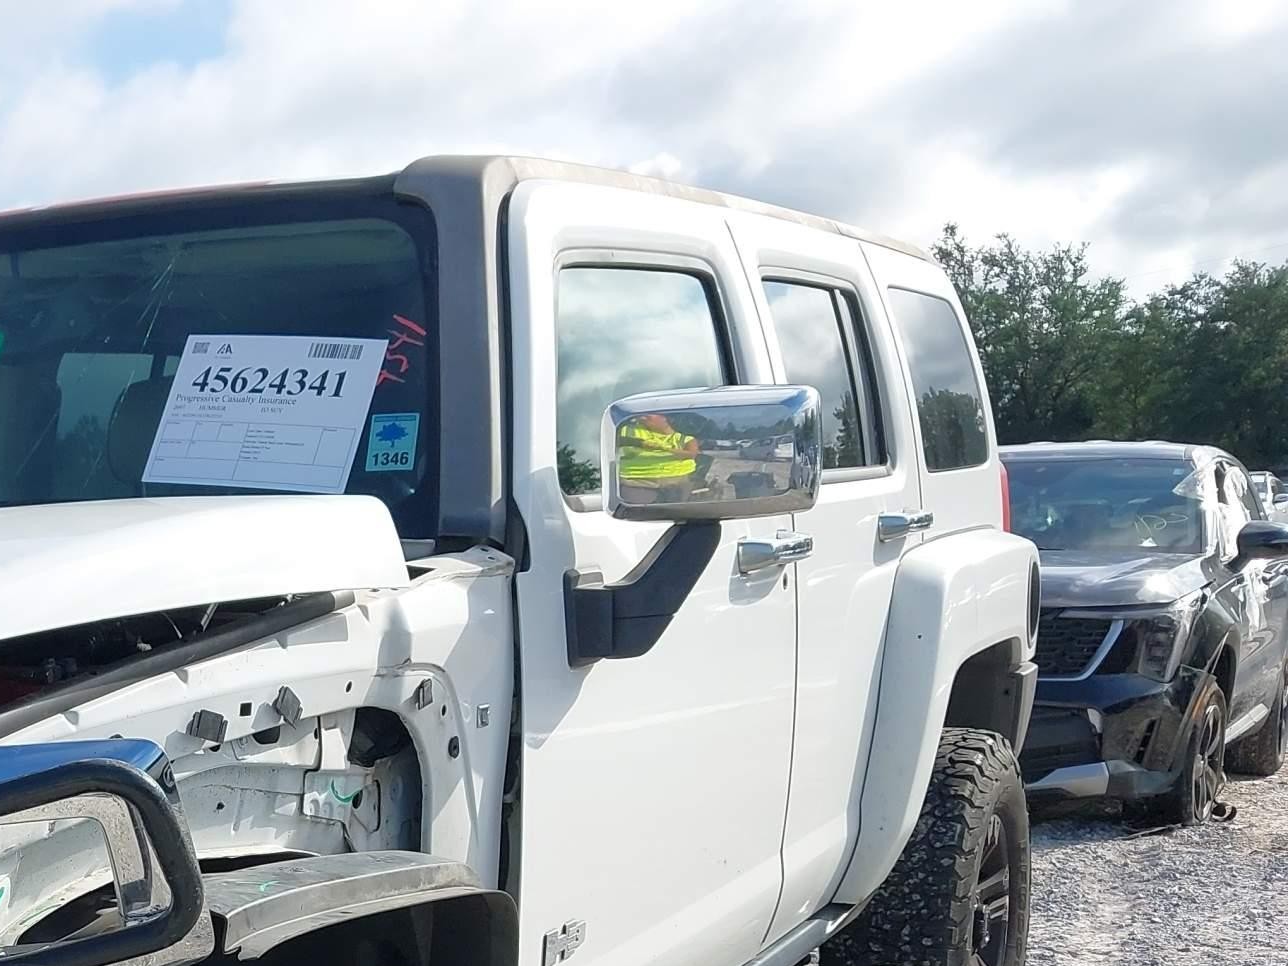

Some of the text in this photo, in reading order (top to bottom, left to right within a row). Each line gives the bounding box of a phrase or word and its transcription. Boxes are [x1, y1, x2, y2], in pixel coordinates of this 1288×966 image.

[192, 366, 347, 398] 45624341
[176, 393, 297, 406] Progressive Casualty Insurance
[372, 451, 409, 466] 1346
